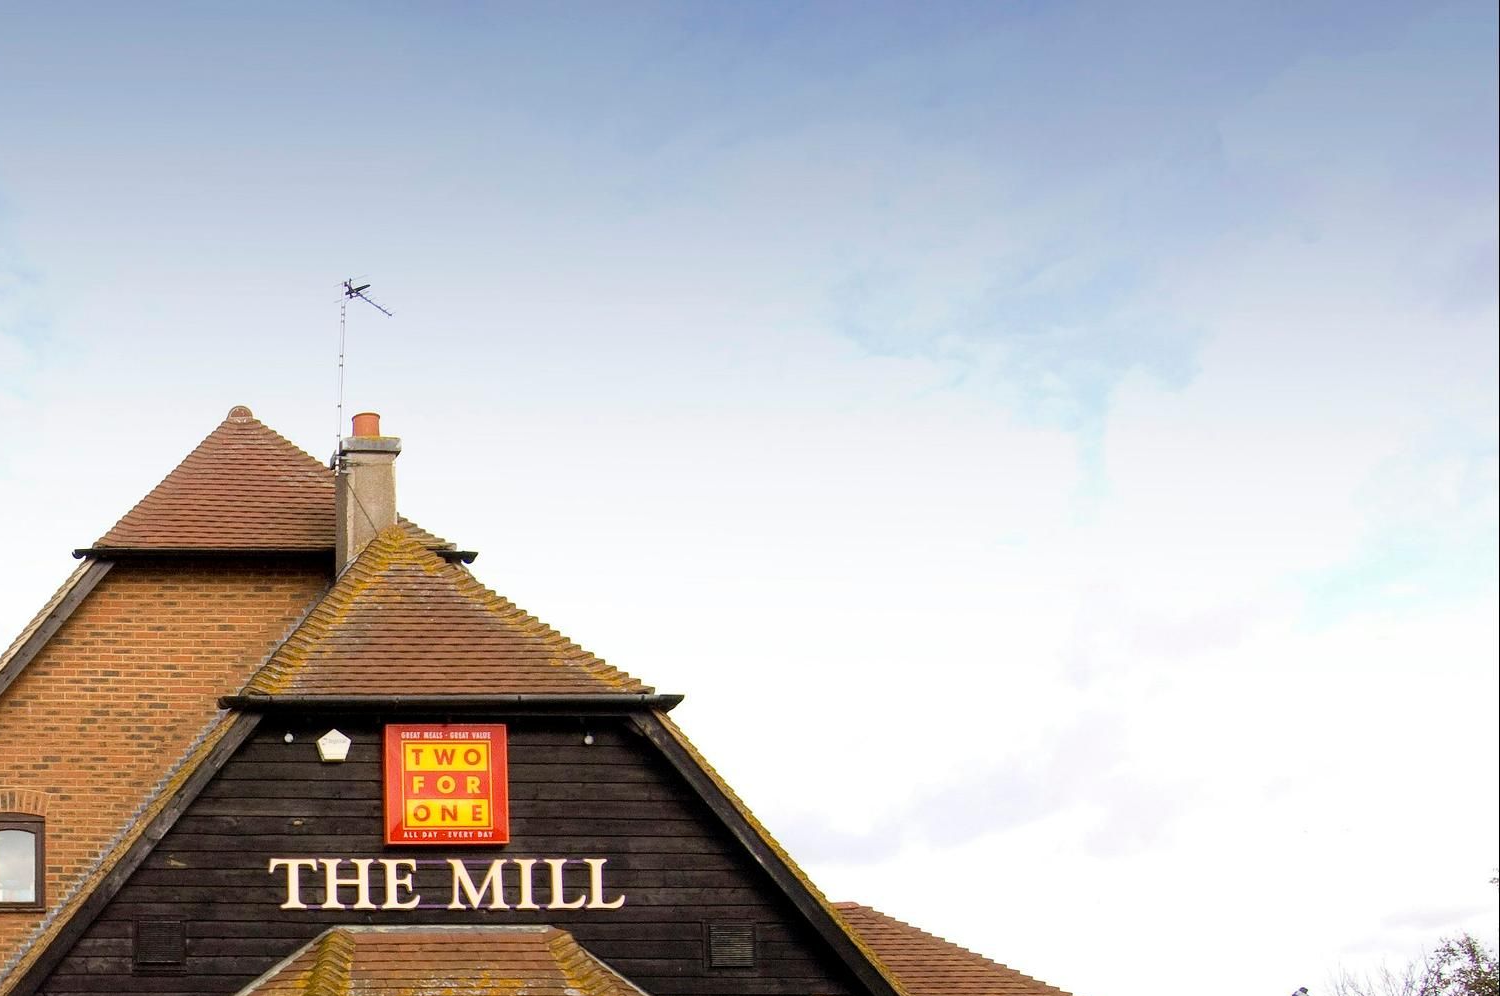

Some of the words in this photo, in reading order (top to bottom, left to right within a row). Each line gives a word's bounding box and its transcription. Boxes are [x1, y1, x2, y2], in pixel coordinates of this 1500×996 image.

[401, 731, 421, 739] GREAT
[423, 731, 443, 739] MEALS
[449, 731, 469, 739] GREAT
[472, 731, 492, 739] VALUE
[411, 748, 482, 766] TWO
[411, 775, 482, 795] FOR
[413, 804, 483, 822] ONE
[403, 831, 418, 839] ALL
[422, 831, 438, 839] DAY
[448, 831, 474, 839] EVERY
[477, 831, 493, 839] DAY
[268, 857, 421, 911] THE
[445, 857, 626, 911] MILL
